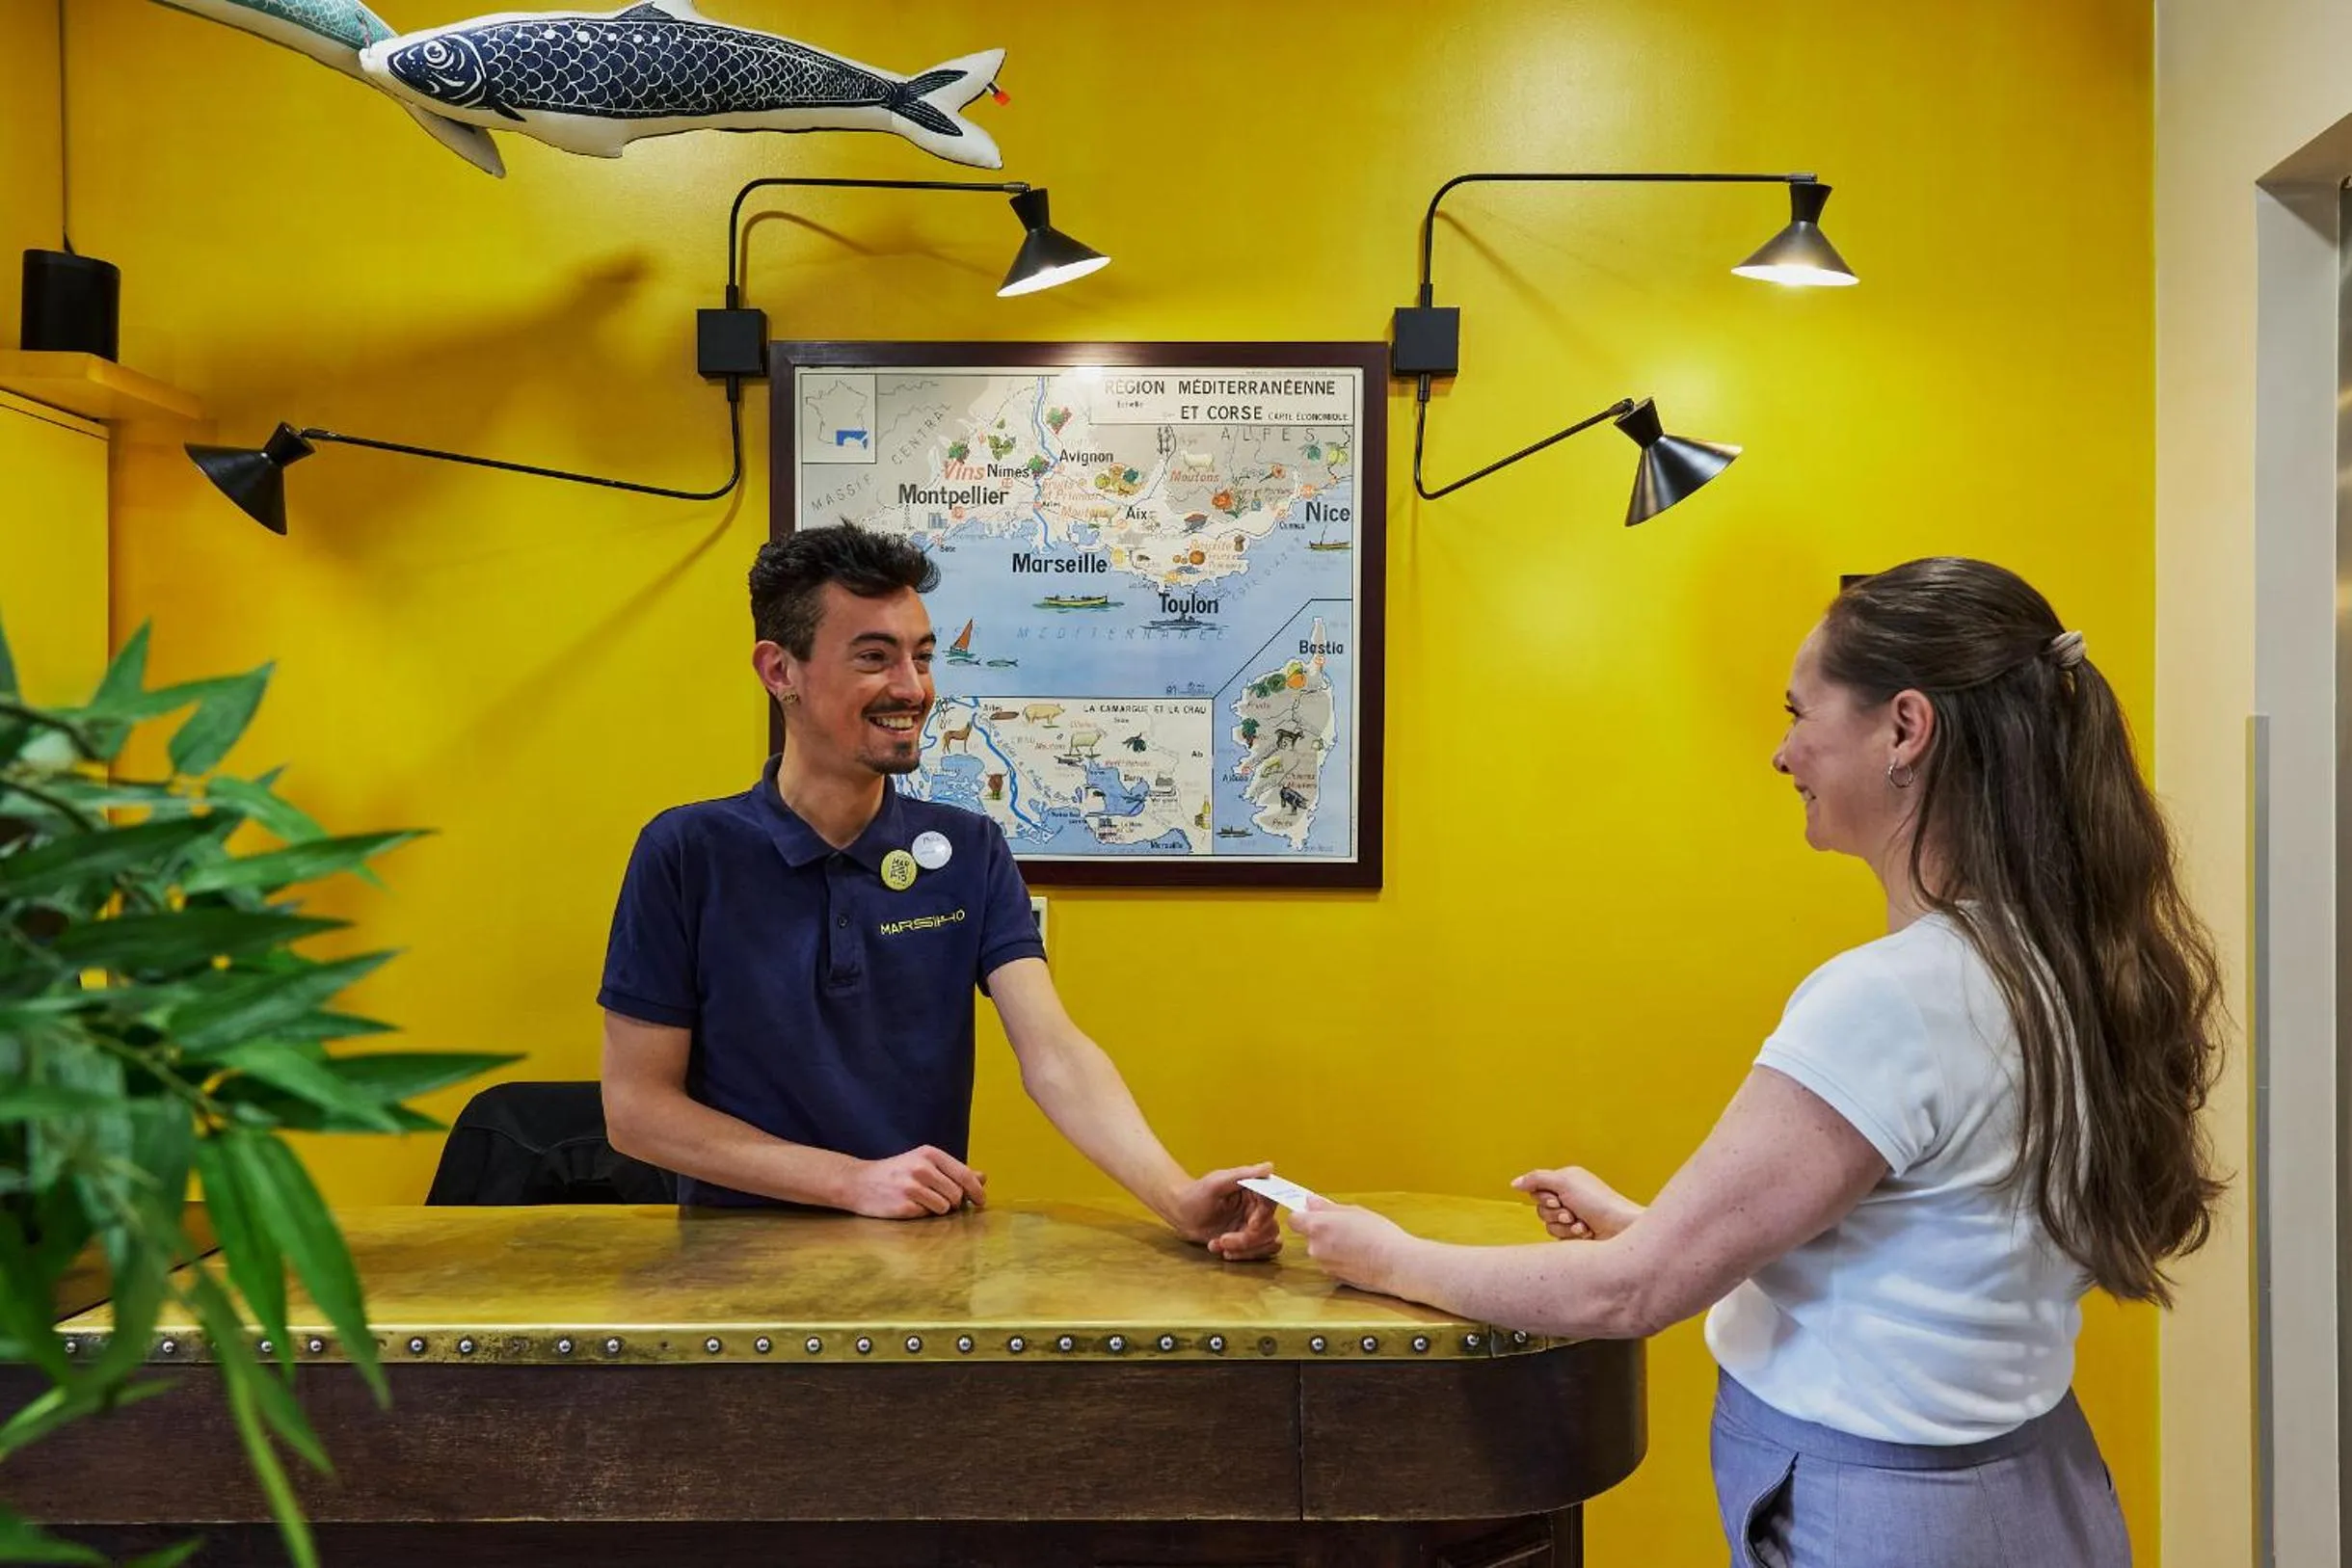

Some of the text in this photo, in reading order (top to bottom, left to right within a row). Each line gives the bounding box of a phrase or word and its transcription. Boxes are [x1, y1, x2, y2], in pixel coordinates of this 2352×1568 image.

[1105, 379, 1336, 395] RÉGION MÉDITERRANÉENNE
[1180, 406, 1199, 420] ET
[1207, 406, 1263, 420] CORSE
[1059, 449, 1113, 465] Avignon
[943, 461, 984, 481] Vins
[1170, 469, 1220, 483] Moutons
[898, 484, 1009, 510] Montpellier
[1126, 506, 1148, 520] Aix
[1305, 502, 1350, 522] Nice
[1012, 553, 1108, 573] Marseille
[1158, 593, 1219, 614] Toulon
[1299, 640, 1344, 655] Bastia
